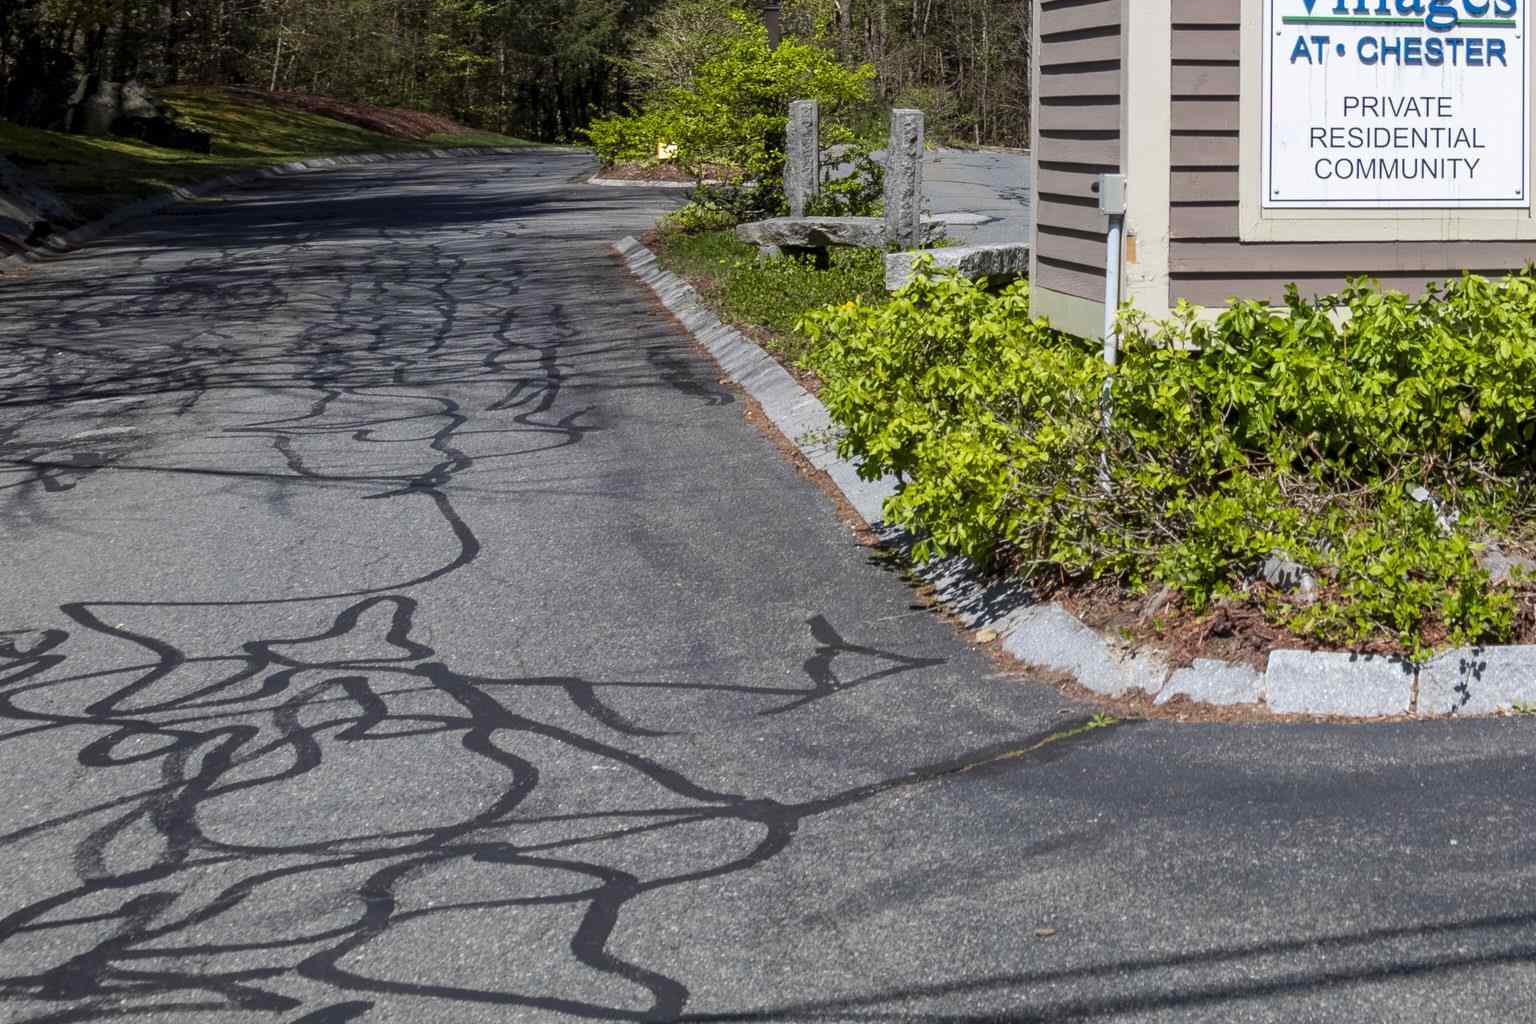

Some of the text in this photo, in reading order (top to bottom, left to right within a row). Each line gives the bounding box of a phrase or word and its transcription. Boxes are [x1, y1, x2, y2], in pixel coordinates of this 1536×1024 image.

[1356, 36, 1508, 68] CHESTER
[1343, 95, 1453, 118] PRIVATE
[1310, 126, 1486, 149] RESIDENTIAL
[1314, 157, 1481, 180] COMMUNITY
